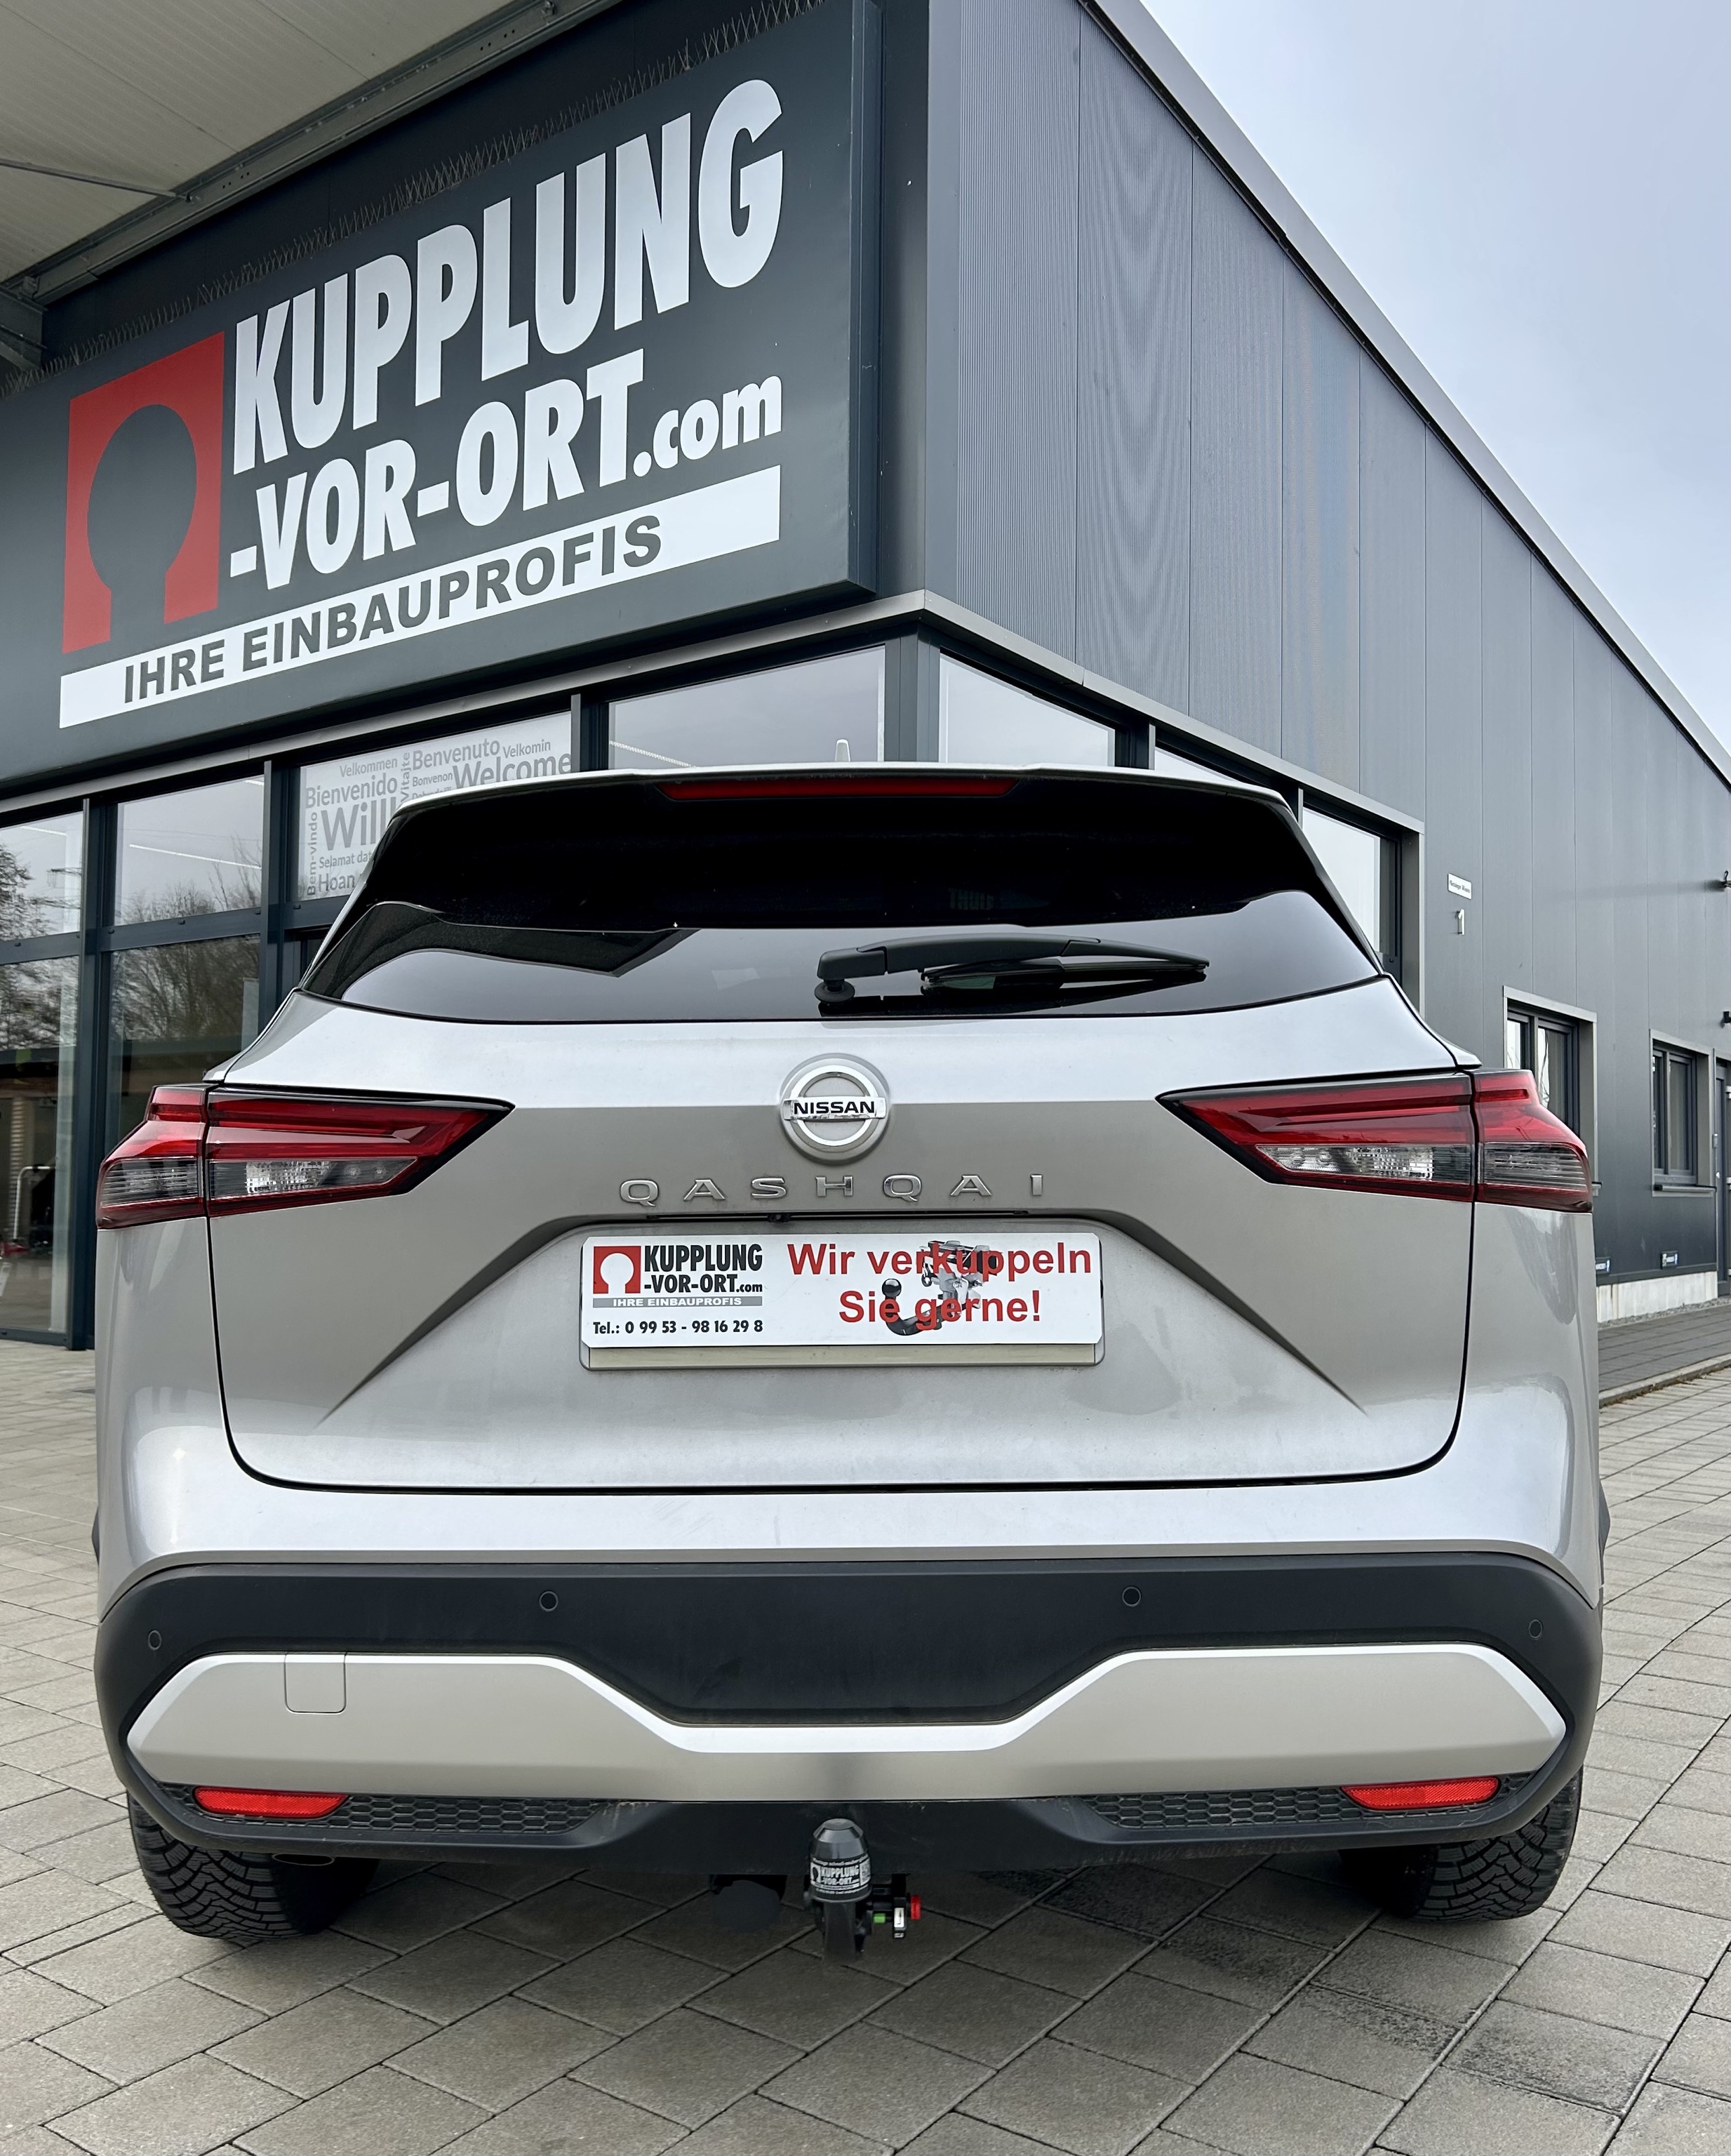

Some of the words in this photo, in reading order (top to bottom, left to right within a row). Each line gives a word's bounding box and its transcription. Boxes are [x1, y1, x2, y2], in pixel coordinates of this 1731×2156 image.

[232, 79, 783, 474] KUPPLUNG
[230, 348, 782, 590] -VOR-ORT.com
[124, 639, 225, 703] IHRE
[241, 515, 662, 672] EINBAUPROFIS
[413, 738, 500, 771] Benvenuto
[502, 739, 551, 759] Velkomin
[340, 758, 398, 778] Velkommen
[401, 752, 411, 802] Vitajte
[413, 772, 453, 787] Bonvenon
[453, 753, 572, 789] Welcome
[306, 773, 398, 808] Bienvenido
[307, 812, 318, 896] Bem-vindo
[319, 853, 356, 868] Selamat
[319, 873, 356, 892] Hoan
[1457, 908, 1465, 935] 1
[794, 1100, 875, 1114] NISSAN
[620, 1173, 1044, 1206] QASHQAI
[644, 1244, 763, 1272] KUPPLUNG
[787, 1243, 855, 1275] Wir
[867, 1242, 1092, 1282] verkuppeln
[644, 1274, 763, 1293] -VOR-ORT.com
[613, 1298, 644, 1307] IHRE
[647, 1297, 742, 1306] EINBAUPROFIS
[839, 1290, 900, 1324] Sie
[914, 1290, 1041, 1331] gerne!
[593, 1322, 620, 1334] Tel.:
[625, 1321, 634, 1333] 0
[639, 1321, 657, 1333] 99
[662, 1321, 676, 1333] 53
[692, 1321, 709, 1333] 98
[715, 1320, 728, 1333] 16
[733, 1320, 749, 1332] 29
[754, 1320, 763, 1332] 8
[821, 1865, 859, 1877] KUPPLUNG
